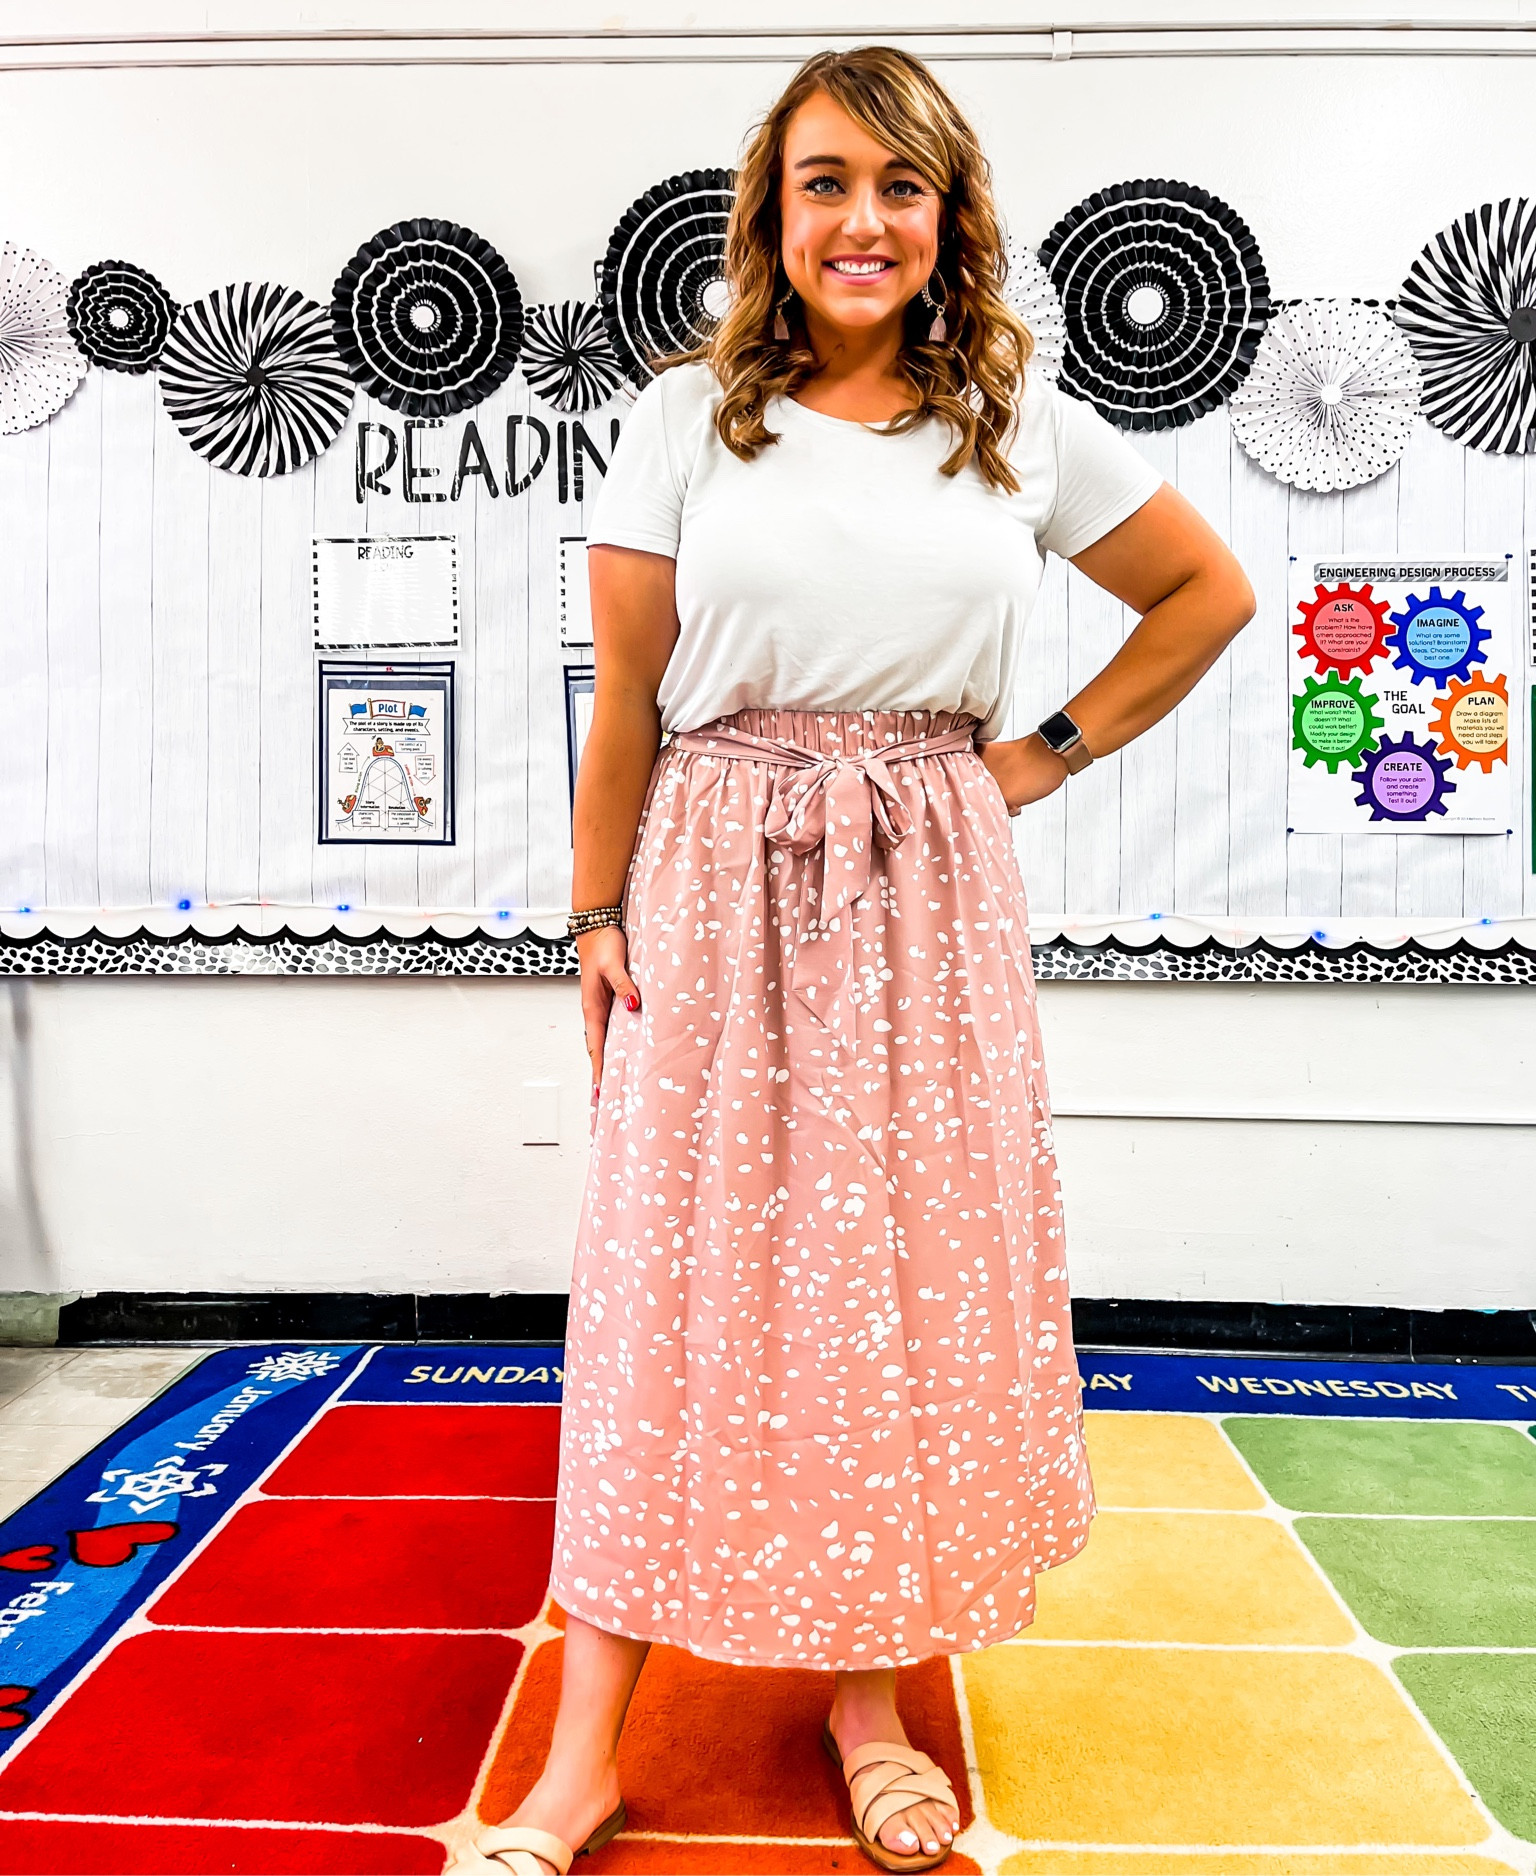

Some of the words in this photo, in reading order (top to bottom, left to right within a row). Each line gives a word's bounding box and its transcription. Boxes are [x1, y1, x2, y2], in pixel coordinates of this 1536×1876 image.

[358, 545, 414, 559] READING
[1320, 568, 1396, 578] ENGINEERING
[1400, 568, 1440, 577] DESIGN
[1444, 567, 1495, 577] PROCESS
[1334, 604, 1354, 612] ASK
[1417, 619, 1459, 627] IMAGINE
[1384, 691, 1408, 701] THE
[1311, 700, 1356, 708] IMPROVE
[1468, 697, 1495, 705] PLAN
[379, 704, 398, 713] Plot
[1392, 704, 1425, 714] GOAL
[1384, 763, 1422, 772] CREATE
[1196, 1375, 1458, 1400] WEDNESDAY
[173, 1386, 272, 1451] January
